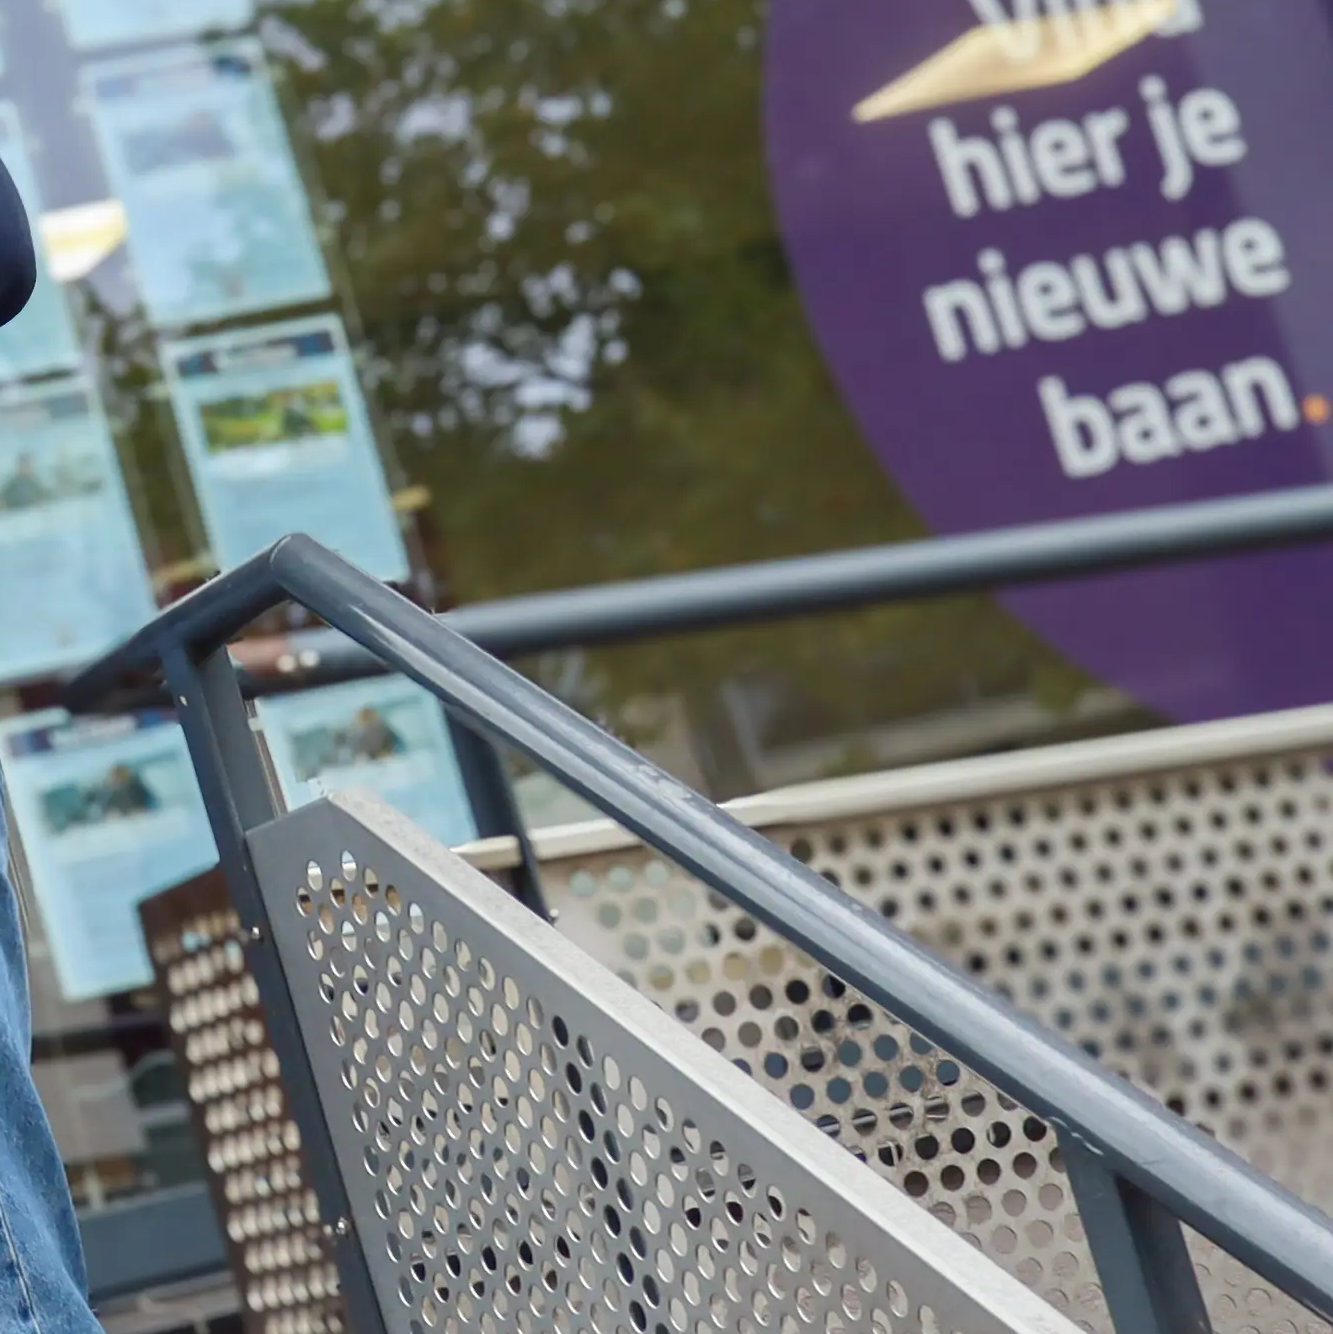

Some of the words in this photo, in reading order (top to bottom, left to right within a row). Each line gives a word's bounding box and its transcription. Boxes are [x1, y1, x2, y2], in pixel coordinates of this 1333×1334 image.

[928, 105, 1129, 218] hier
[1139, 75, 1247, 200] je
[923, 217, 1291, 362] nieuwe
[1038, 356, 1330, 478] baan.
